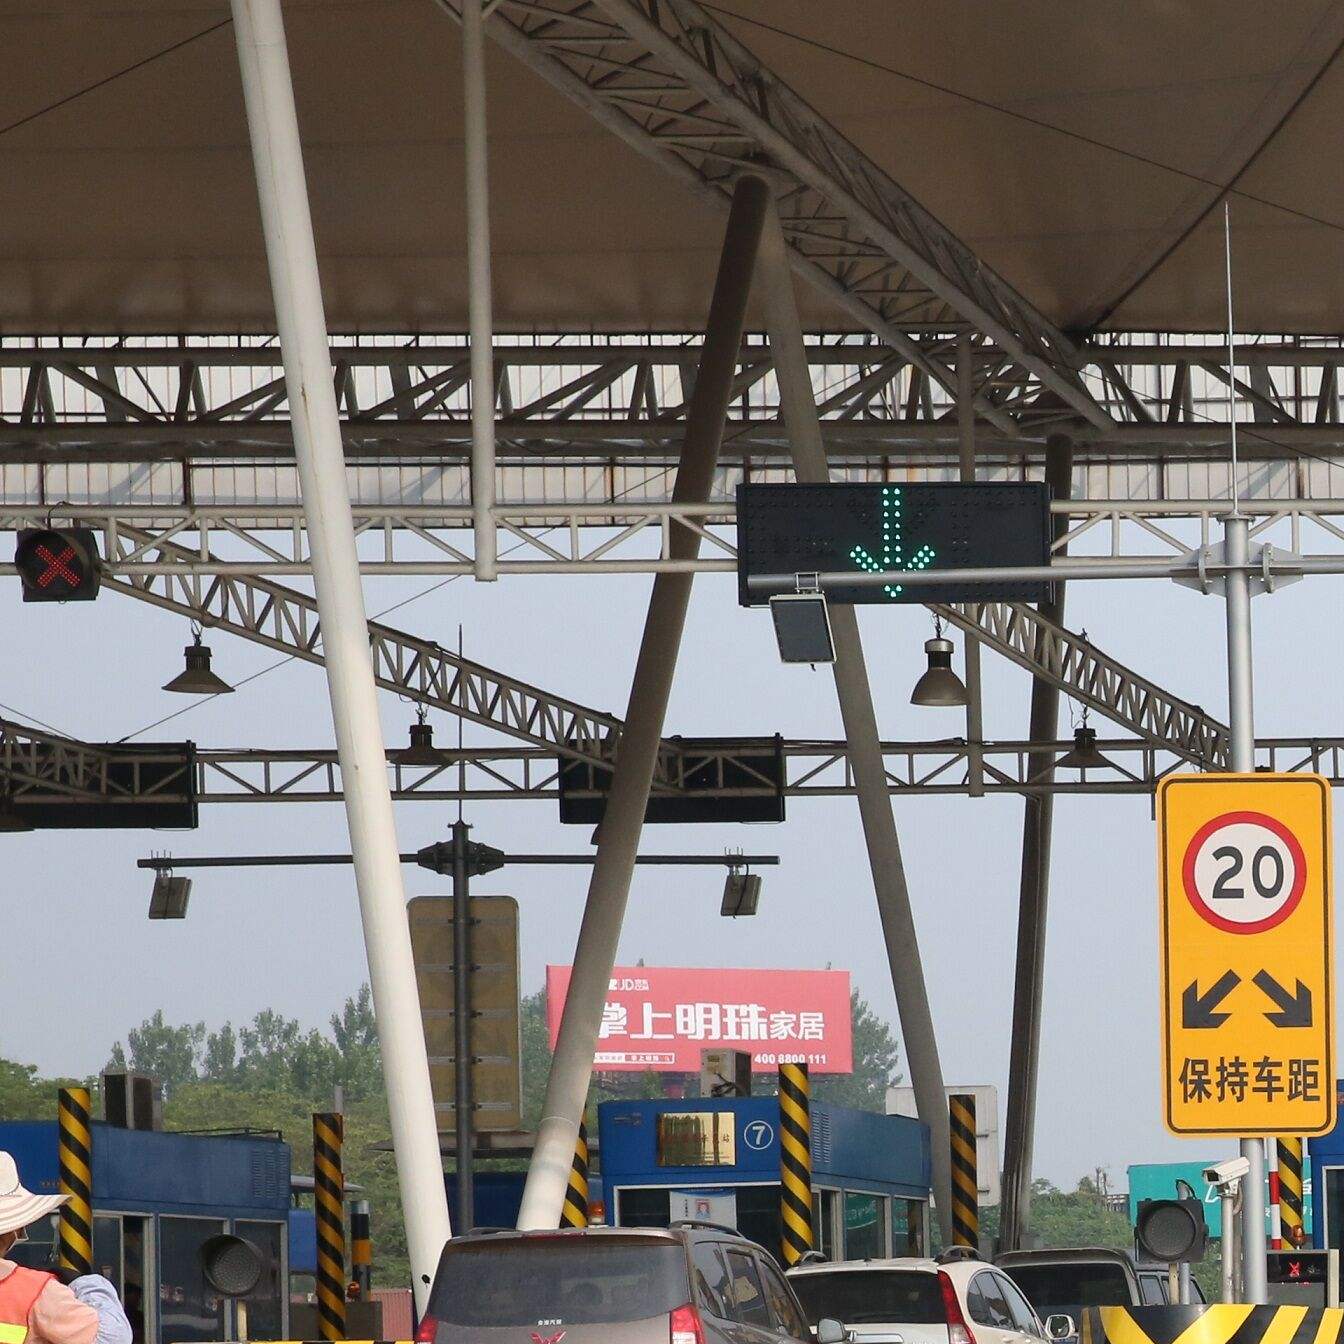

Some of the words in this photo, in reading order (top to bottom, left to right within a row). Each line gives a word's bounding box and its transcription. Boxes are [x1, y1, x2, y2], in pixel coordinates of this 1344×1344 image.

[1212, 845, 1284, 899] 20
[754, 1054, 775, 1064] 400
[778, 1054, 805, 1064] 8800
[809, 1054, 827, 1064] 111
[1179, 1056, 1321, 1103] 保持车距
